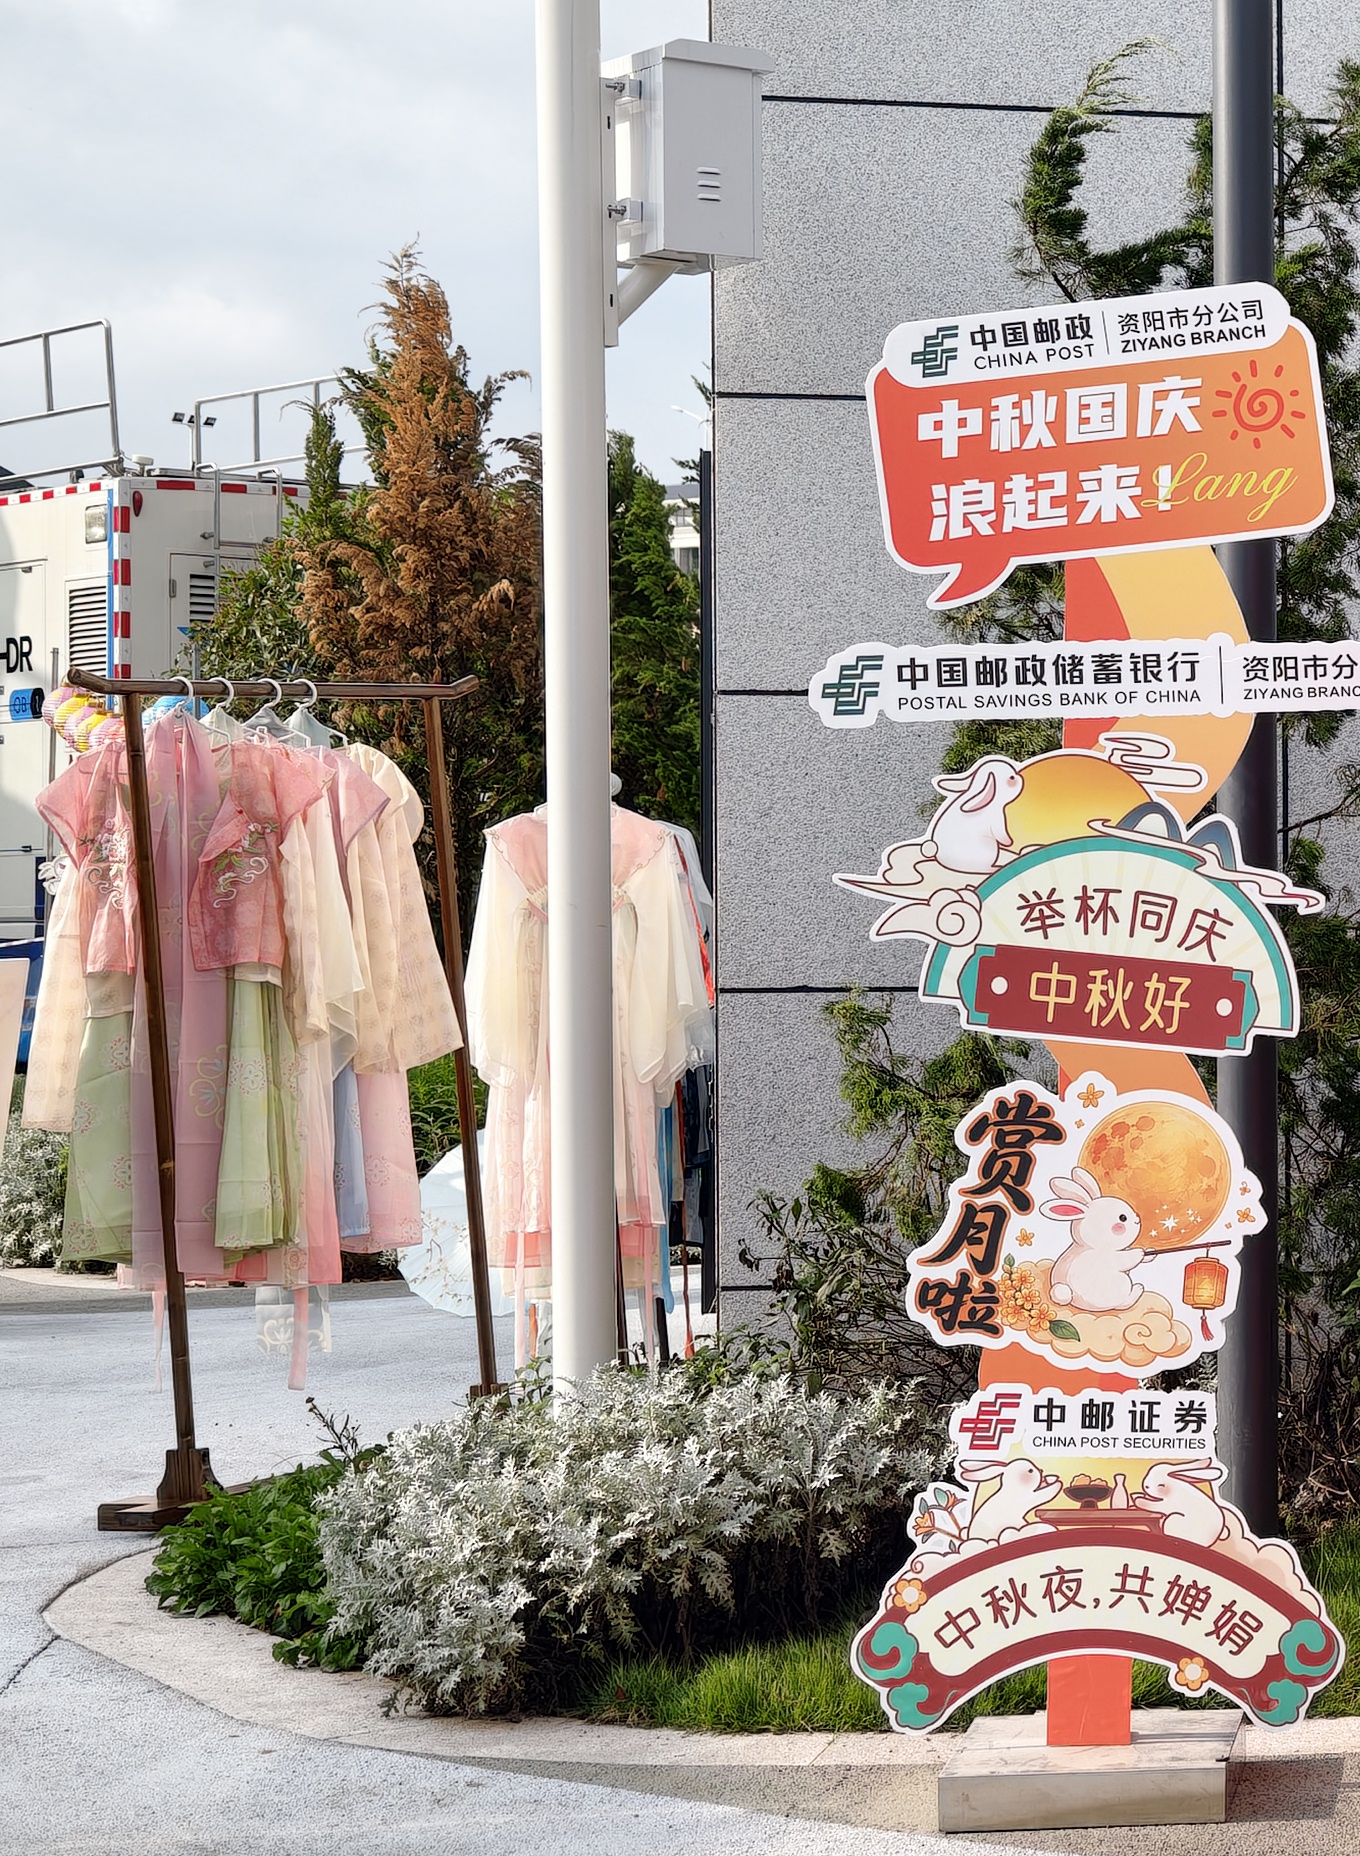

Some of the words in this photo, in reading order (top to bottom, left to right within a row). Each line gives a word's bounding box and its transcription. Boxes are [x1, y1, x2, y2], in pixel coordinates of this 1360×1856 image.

[970, 313, 1094, 353] 中国邮政
[1118, 299, 1264, 337] 资阳市分公司
[973, 350, 1037, 371] CHINA
[1046, 344, 1095, 364] POST
[1121, 333, 1187, 354] ZIYANG
[1191, 324, 1266, 347] BRANCH
[916, 375, 1203, 459] 中秋国庆
[1140, 451, 1299, 523] Lang
[0, 635, 33, 674] DR
[897, 651, 1201, 691] 中国邮政储蓄银行
[898, 696, 967, 711] POSTAL
[974, 693, 1053, 709] SAVINGS
[1059, 691, 1109, 707] BANK
[1115, 690, 1139, 705] OF
[1145, 689, 1202, 704] CHINA
[1243, 686, 1304, 701] ZIYANG
[1017, 885, 1235, 962] 举杯同庆
[1029, 960, 1191, 1035] 中秋好
[917, 1091, 1066, 1335] 赏月啦
[1033, 1397, 1208, 1435] 中邮证券
[1032, 1436, 1077, 1450] CHINA
[1080, 1436, 1119, 1449] POST
[1122, 1436, 1206, 1449] SECURITIES
[933, 1563, 1264, 1657] 中秋夜,共婵娟
